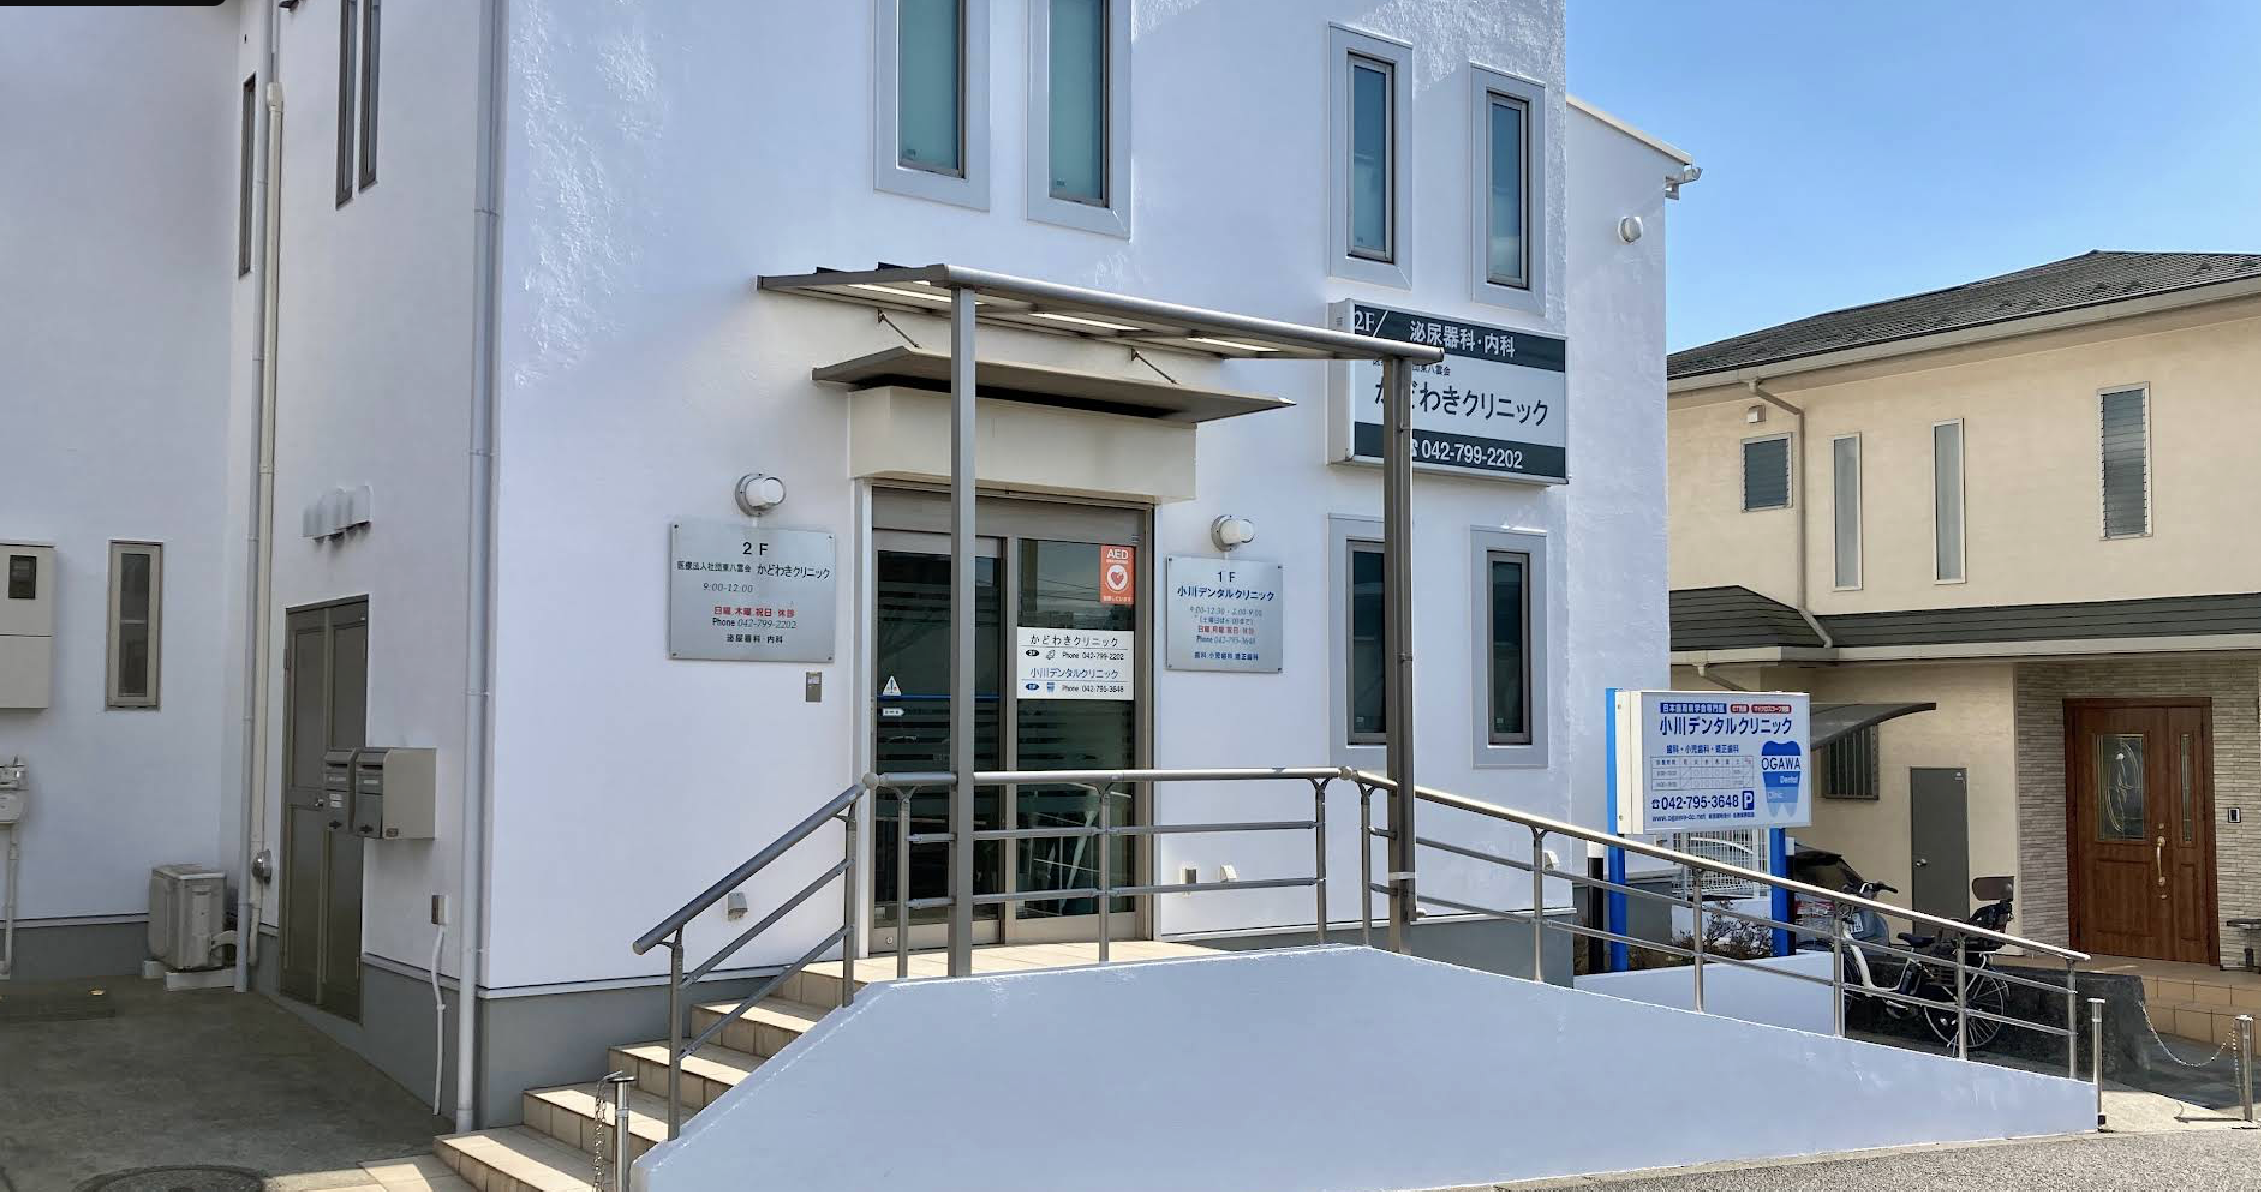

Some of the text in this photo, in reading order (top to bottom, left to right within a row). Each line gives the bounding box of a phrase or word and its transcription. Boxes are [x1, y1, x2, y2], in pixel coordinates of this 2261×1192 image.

[1422, 439, 1523, 469] 042-799-2202
[1106, 548, 1128, 559] AED
[757, 563, 830, 579] かどわきクリニック
[703, 582, 753, 593] 9:00-12:00
[1177, 586, 1274, 601] 小川デンタルクリニック
[1031, 635, 1118, 646] かどわきクリニック
[1062, 651, 1080, 659] Phone
[1031, 667, 1118, 679] 小川デンタルクリニック
[1660, 716, 1792, 735] 小川デンタルクリニック
[1761, 757, 1800, 770] OGAWA
